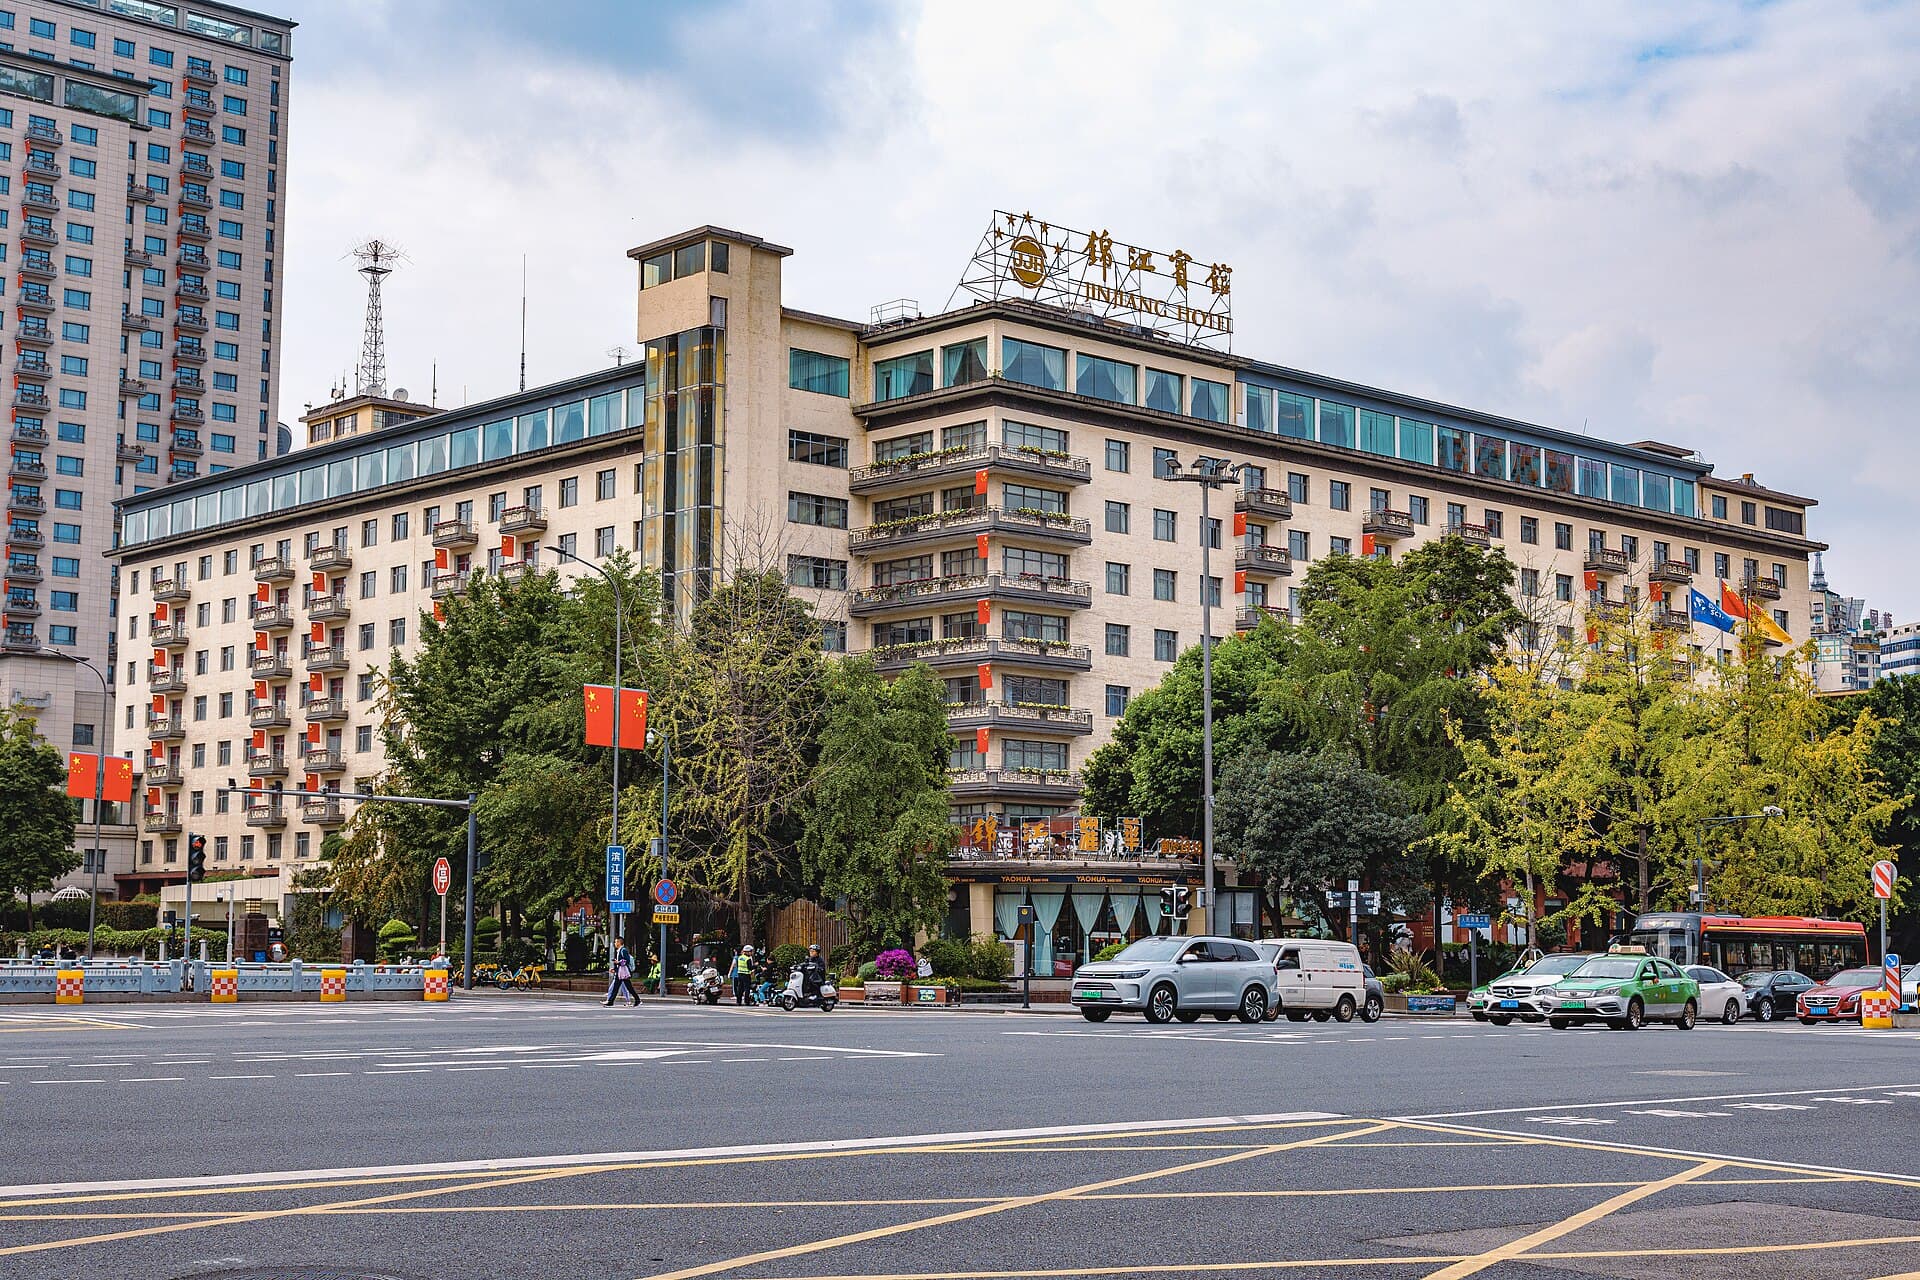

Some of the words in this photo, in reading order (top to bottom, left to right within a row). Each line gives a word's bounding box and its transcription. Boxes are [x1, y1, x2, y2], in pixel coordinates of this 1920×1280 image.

[1085, 282, 1167, 317] JINJIANG
[1177, 305, 1231, 333] HOTEL
[437, 864, 447, 889] 停
[611, 852, 620, 896] 滨江西路
